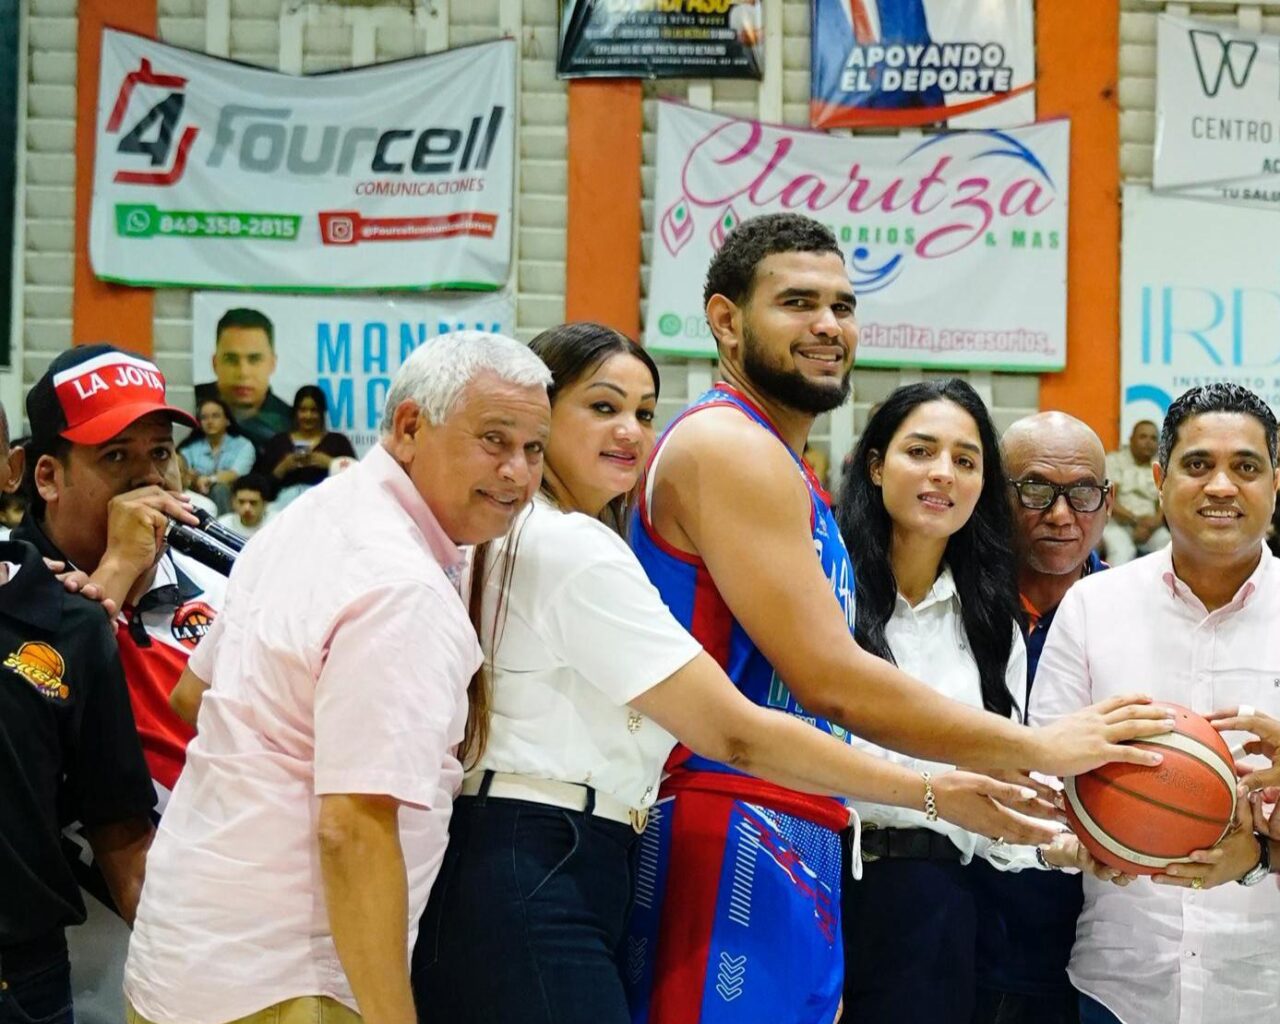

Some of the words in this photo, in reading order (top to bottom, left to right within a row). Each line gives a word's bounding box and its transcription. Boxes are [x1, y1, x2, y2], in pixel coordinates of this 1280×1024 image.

[847, 43, 1004, 68] APOYANDO
[840, 70, 872, 92] EL
[881, 69, 1012, 92] DEPORTE
[1191, 117, 1273, 144] CENTRO
[355, 178, 485, 197] COMUNICACIONES
[682, 121, 1054, 259] Claritza
[830, 226, 915, 247] ORIOS
[1012, 231, 1060, 249] MAS
[317, 322, 501, 373] MAN
[72, 373, 109, 400] LA
[115, 366, 164, 391] JOYA
